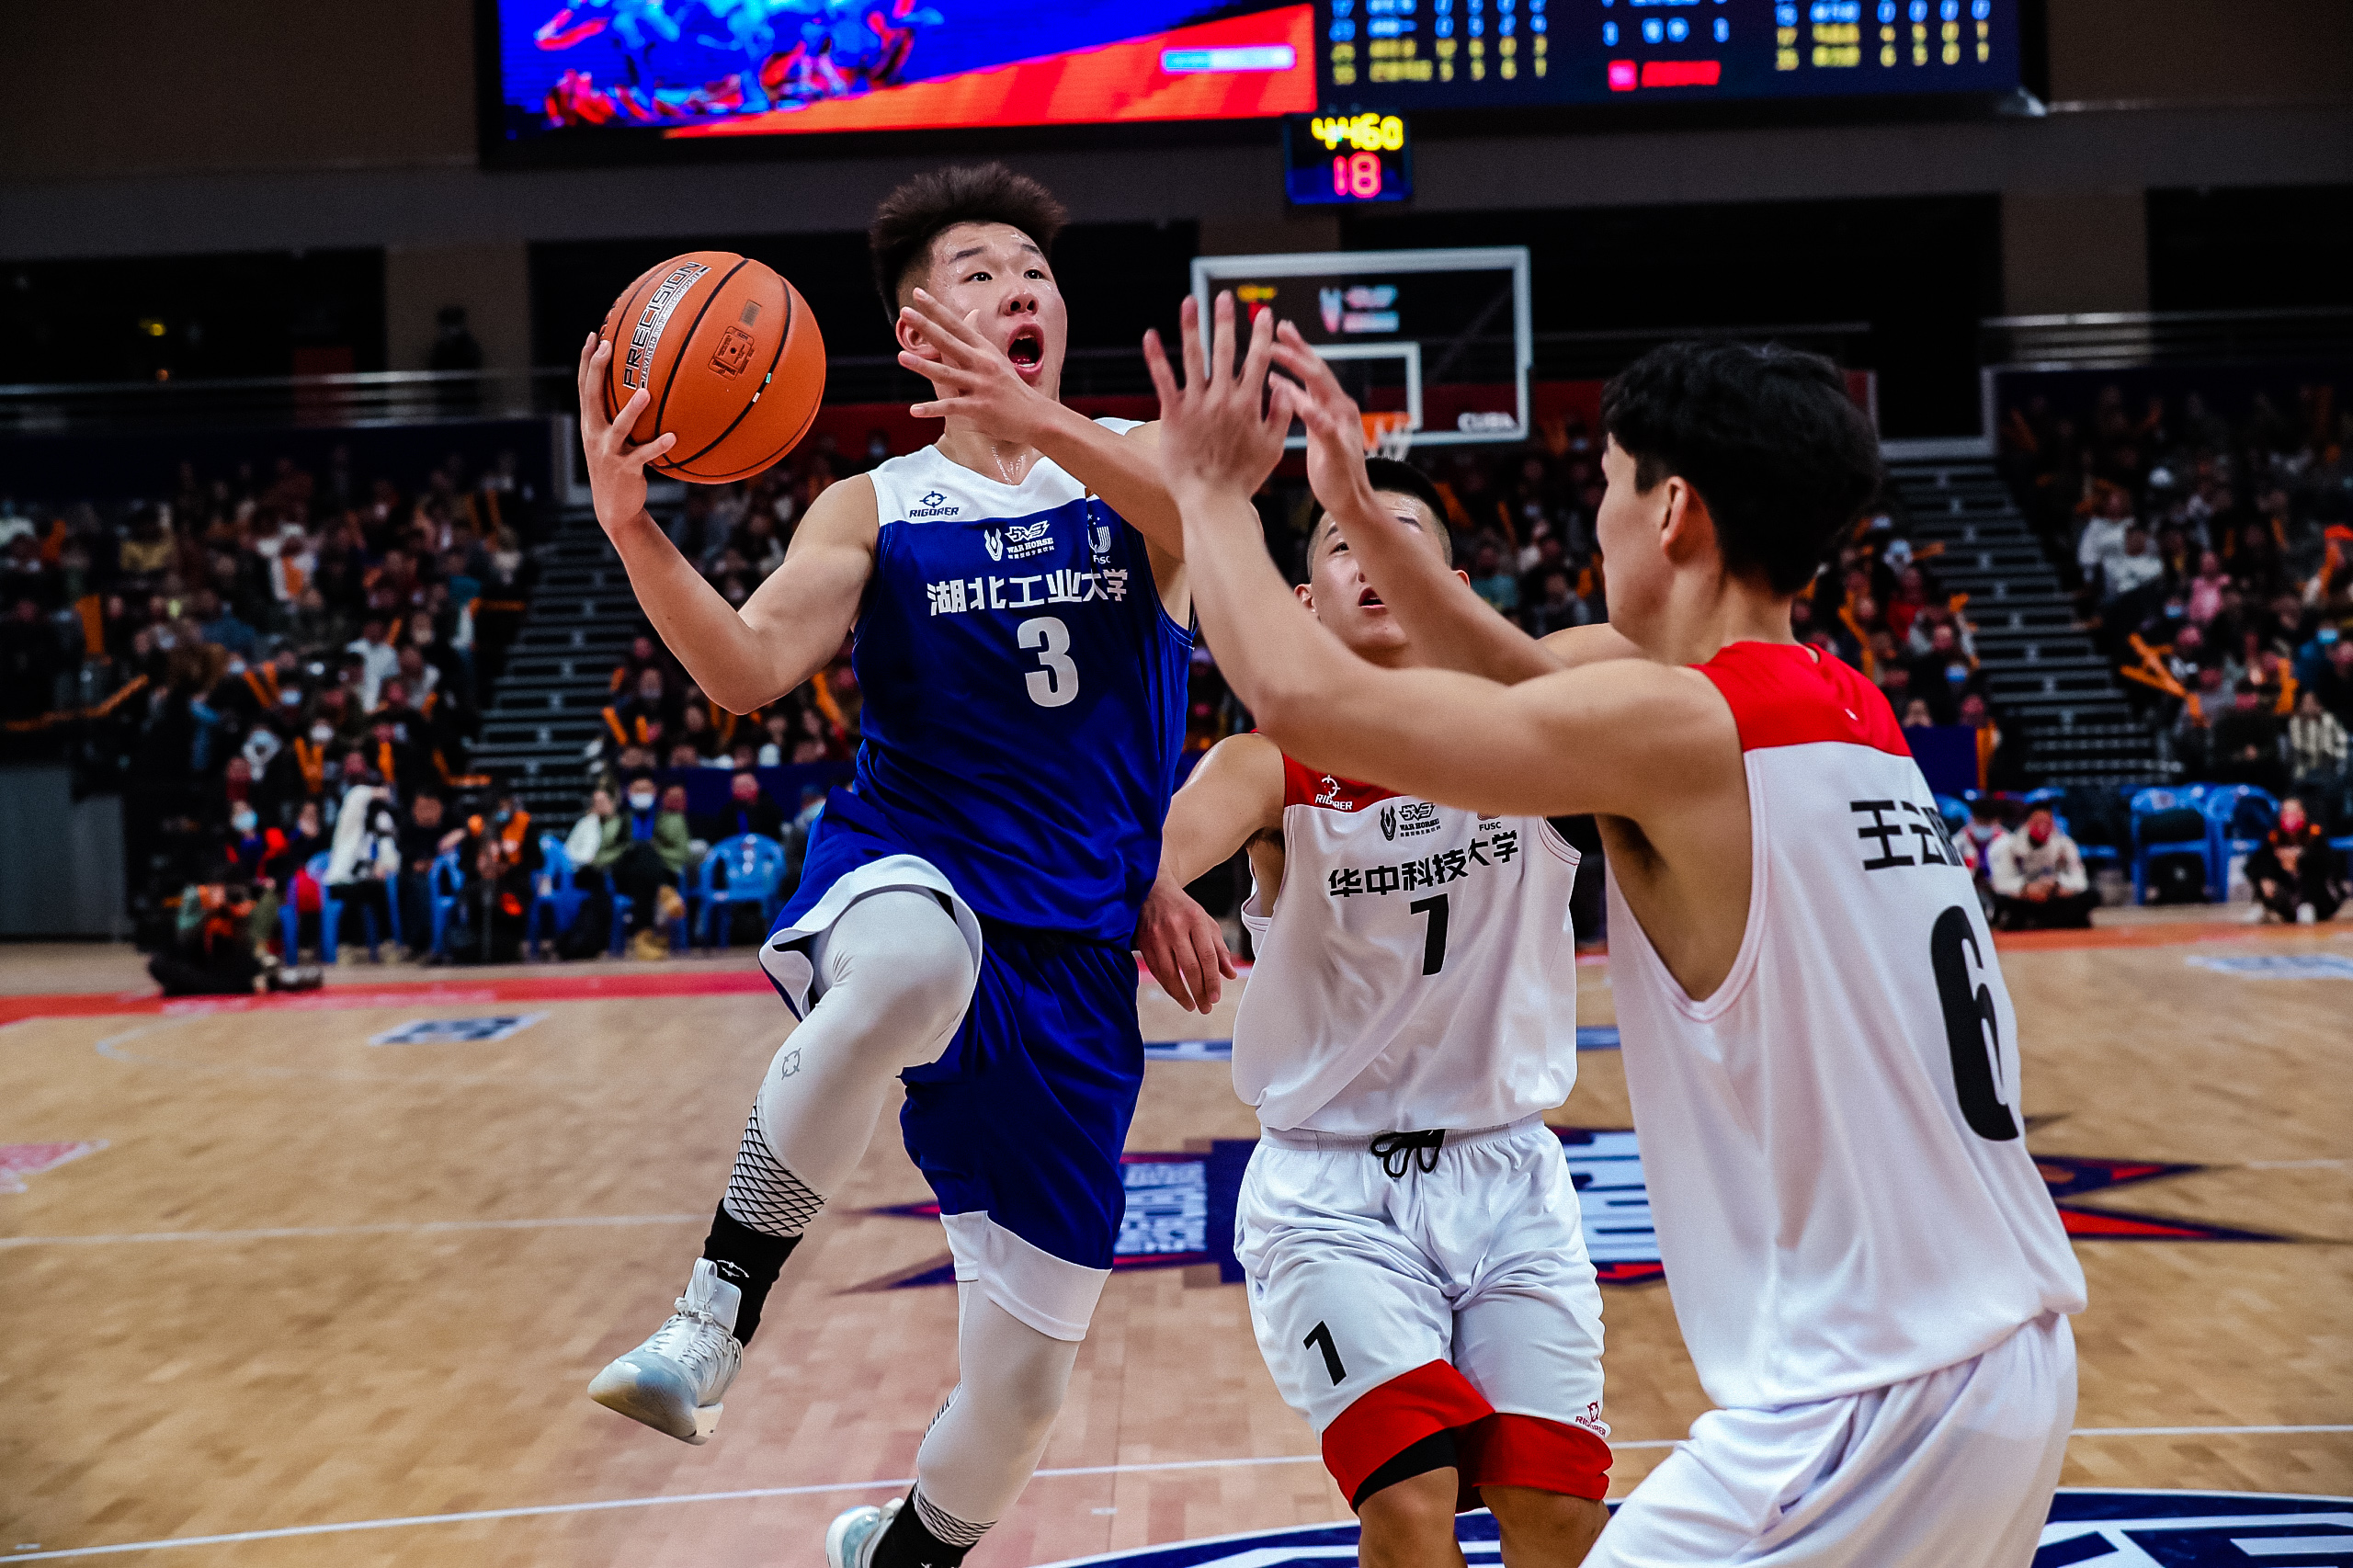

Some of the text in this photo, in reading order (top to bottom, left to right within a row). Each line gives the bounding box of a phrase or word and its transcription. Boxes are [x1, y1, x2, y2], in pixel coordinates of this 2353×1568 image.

[1333, 152, 1381, 199] 18
[623, 261, 702, 390] PRECISION
[909, 506, 960, 518] RIGORER
[1006, 544, 1025, 553] WAR
[1024, 538, 1053, 549] HORSE
[926, 568, 1128, 617] 湖北工业大学
[1017, 616, 1079, 708] 3
[1415, 818, 1440, 829] HORSE
[1478, 821, 1502, 832] FUSC
[1849, 800, 1963, 870] 王云
[1328, 830, 1519, 897] 华中科技大学
[1930, 905, 2019, 1142] 6
[1302, 1320, 1347, 1386] 1
